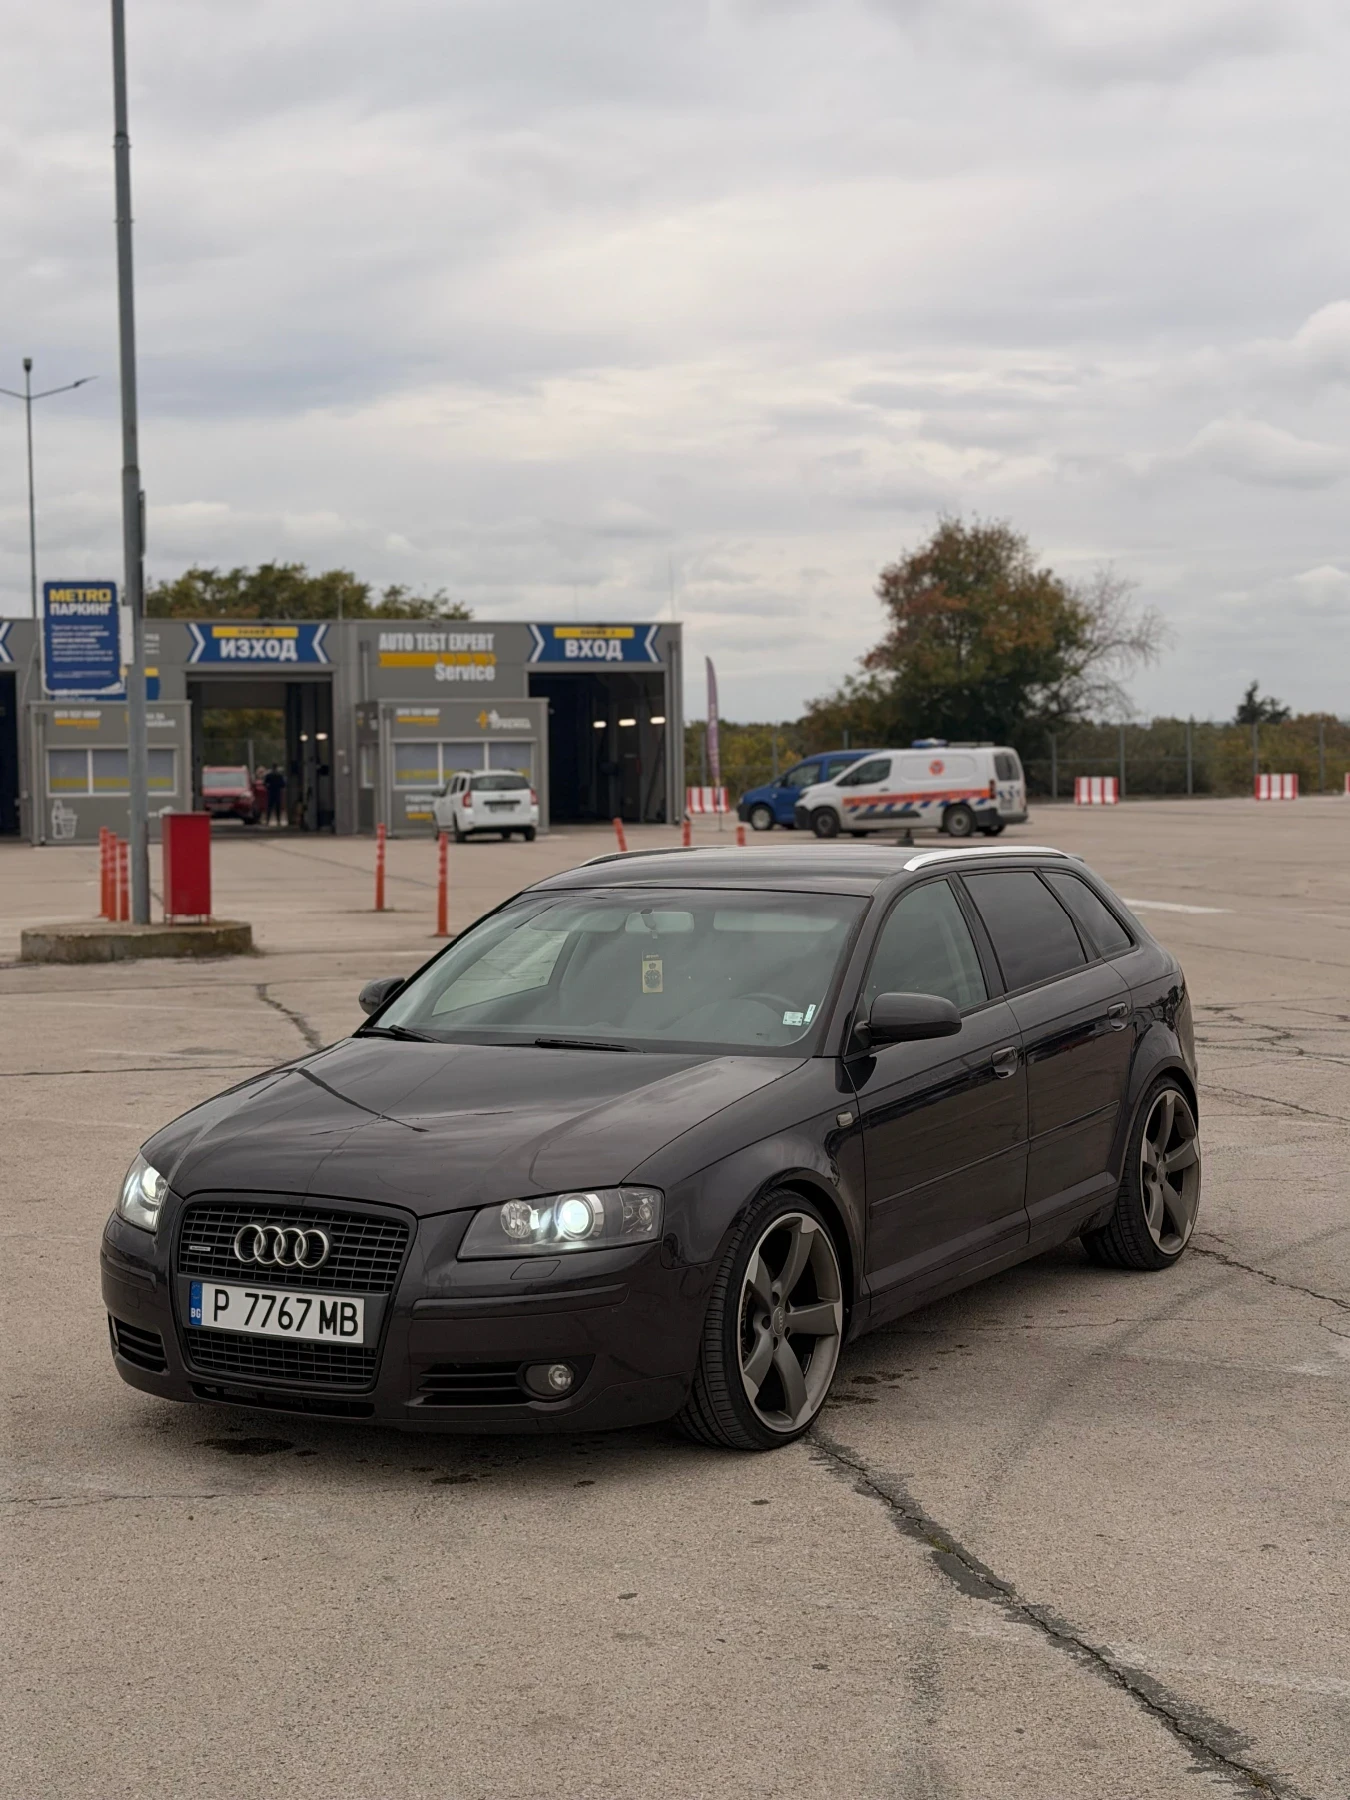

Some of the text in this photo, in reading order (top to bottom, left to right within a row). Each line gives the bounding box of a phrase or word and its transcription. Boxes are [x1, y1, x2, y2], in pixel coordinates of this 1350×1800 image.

[49, 588, 112, 602] METRO
[50, 603, 112, 616] ПАРКИНГ
[220, 638, 298, 661] ИЗХОД
[379, 633, 495, 650] AUTO TEST EXPERT
[565, 638, 624, 661] ВХОД
[434, 663, 495, 681] Service
[190, 1307, 202, 1319] BG
[213, 1288, 359, 1337] P 7767 MB
